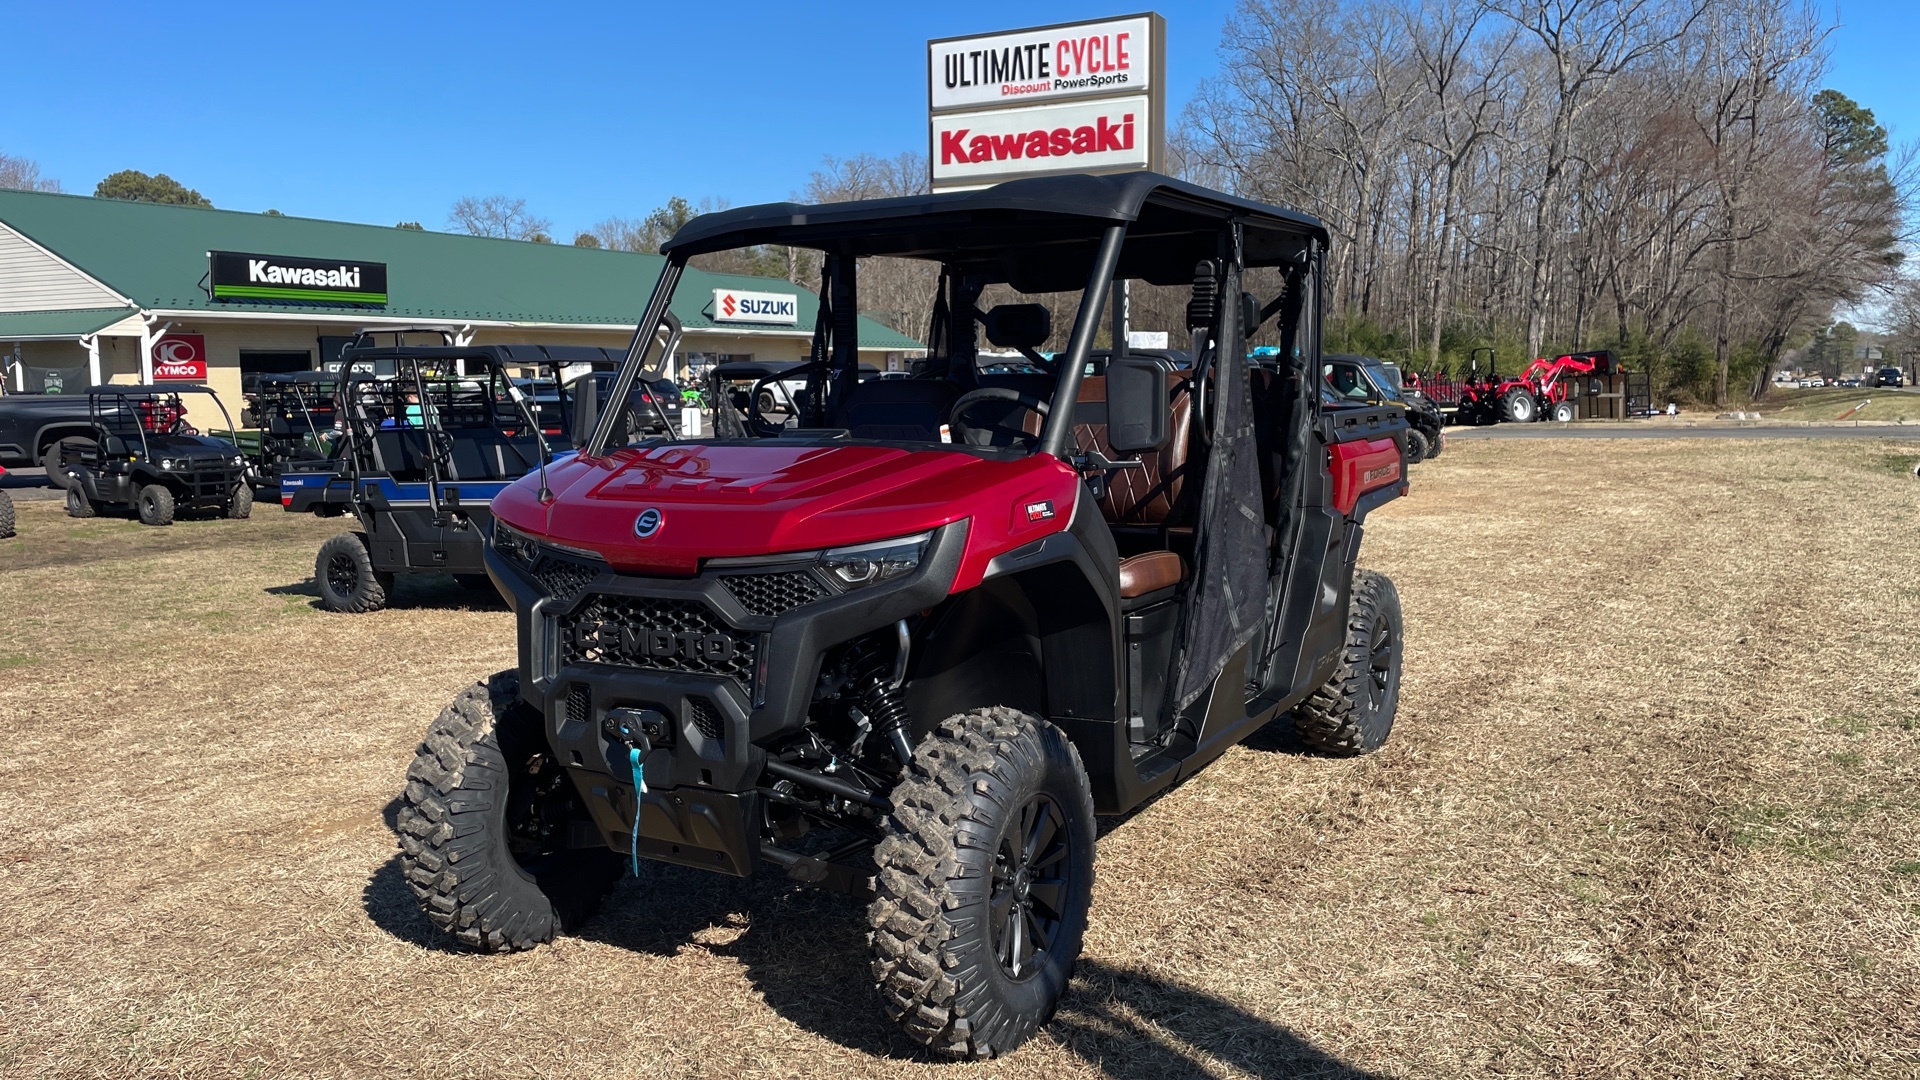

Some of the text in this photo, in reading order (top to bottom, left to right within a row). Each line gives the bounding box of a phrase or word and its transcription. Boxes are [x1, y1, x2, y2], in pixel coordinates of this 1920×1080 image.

[945, 33, 1130, 89] ULTIMATE CYCLE
[1001, 72, 1128, 96] Discount PowerSports
[941, 113, 1134, 165] Kawasaki
[249, 259, 360, 288] Kawasaki
[740, 299, 793, 316] SUZUKI
[153, 365, 197, 376] KYMCO
[575, 622, 734, 662] CFMOTO
